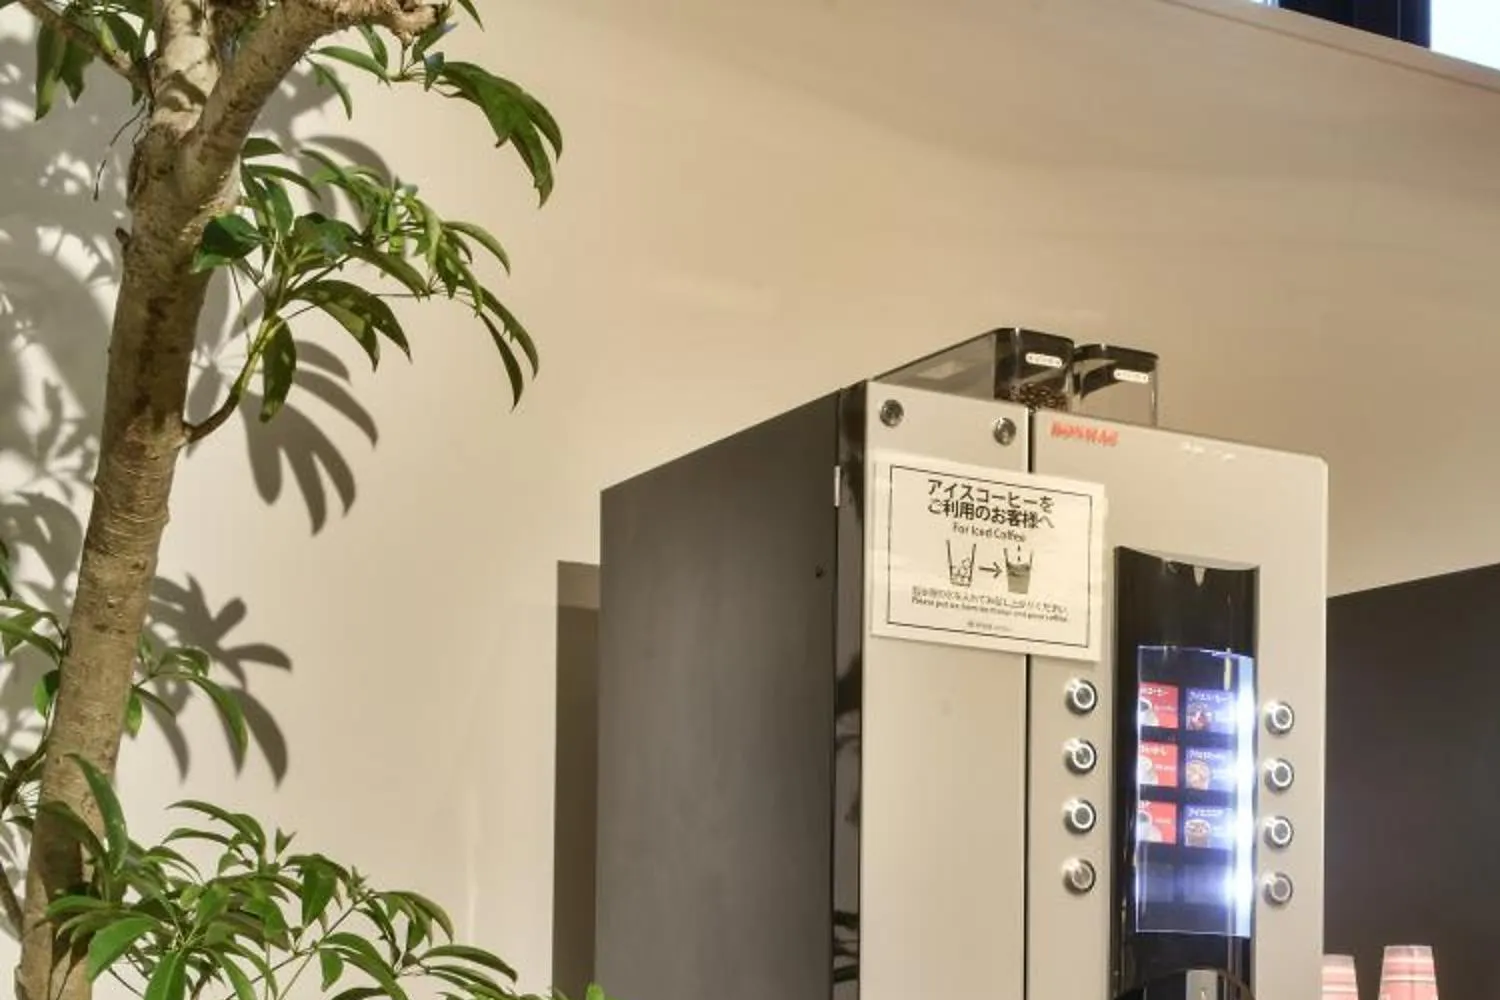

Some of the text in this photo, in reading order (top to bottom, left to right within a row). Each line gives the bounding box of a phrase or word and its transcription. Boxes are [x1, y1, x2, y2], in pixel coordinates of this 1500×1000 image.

[927, 478, 1055, 514] アイスコーヒーを
[927, 498, 1055, 529] ご利用のお客様へ
[953, 521, 1026, 543] For Iced Coffee
